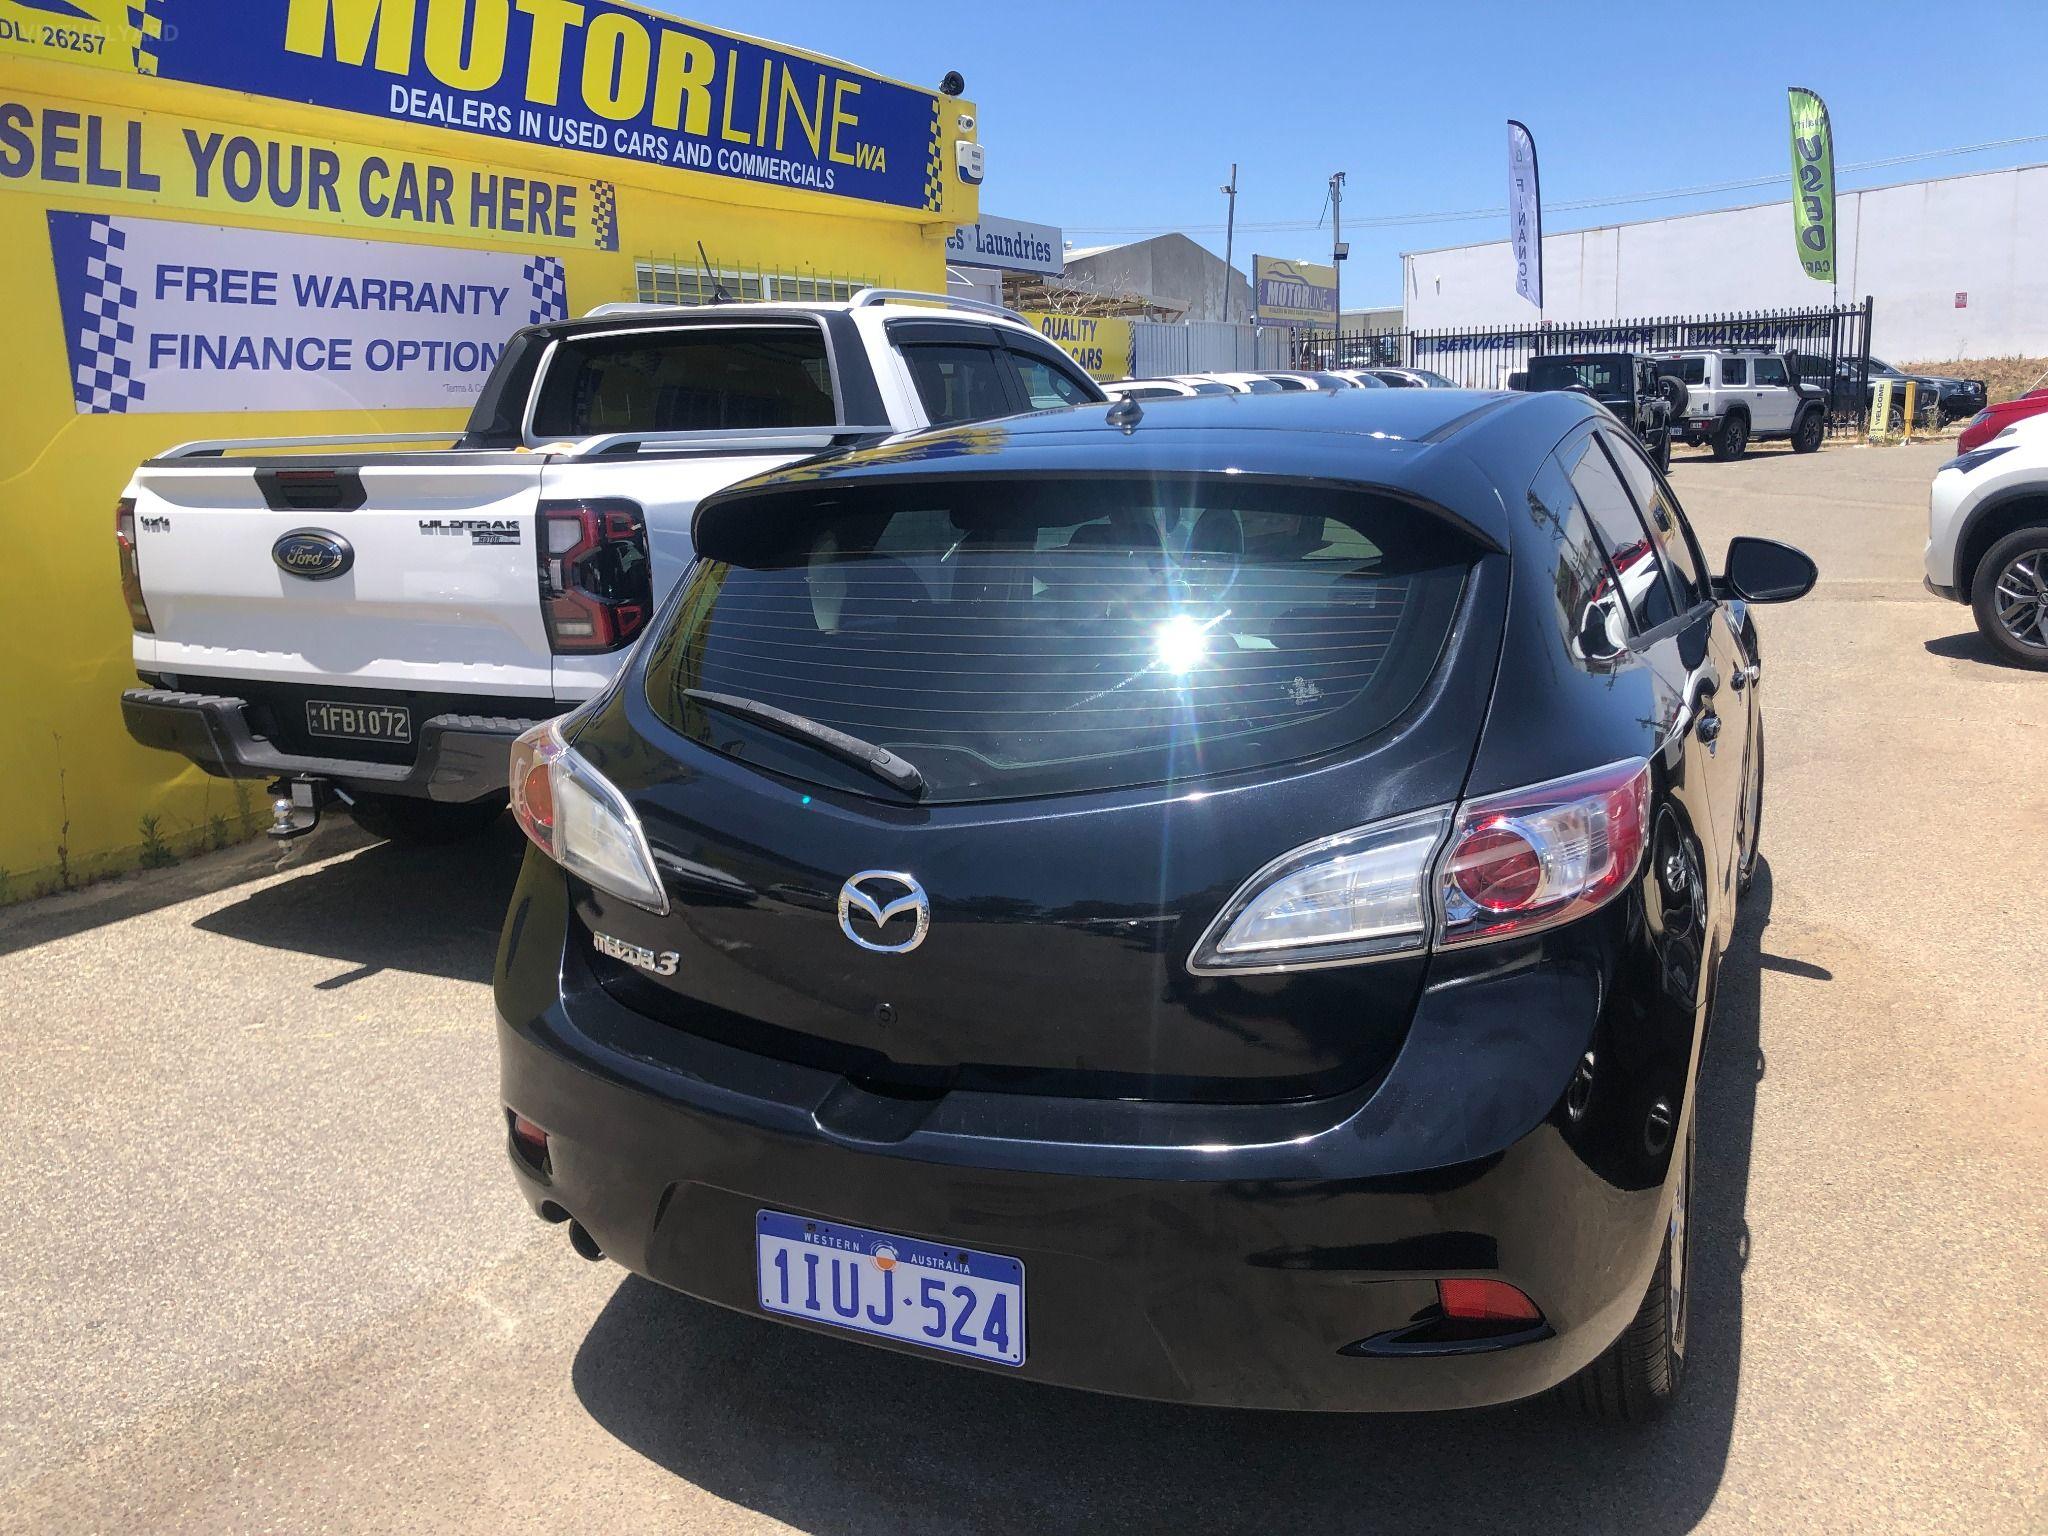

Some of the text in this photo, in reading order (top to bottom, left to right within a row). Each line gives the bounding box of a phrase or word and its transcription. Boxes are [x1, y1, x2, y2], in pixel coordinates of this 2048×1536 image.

[43, 26, 106, 55] 26257
[285, 0, 887, 173] MOTORLINE WA
[390, 84, 835, 190] DEALERS IN USED CARS AND COMMERCIALS
[0, 102, 577, 238] SELL YOUR CAR HERE
[975, 224, 1051, 262] Laundries
[156, 264, 510, 316] FREE WARRANTY
[1266, 280, 1328, 310] MOTORLINE
[1041, 317, 1098, 342] QUALITY
[1436, 334, 1515, 352] SERVICE
[149, 333, 352, 371] FINANCE
[1875, 384, 1885, 425] WELCOME
[419, 520, 520, 529] WILDTRAK
[287, 544, 323, 565] Ford
[320, 707, 408, 737] 1FBI072
[803, 1232, 971, 1275] WESTERN AUSTRALIA
